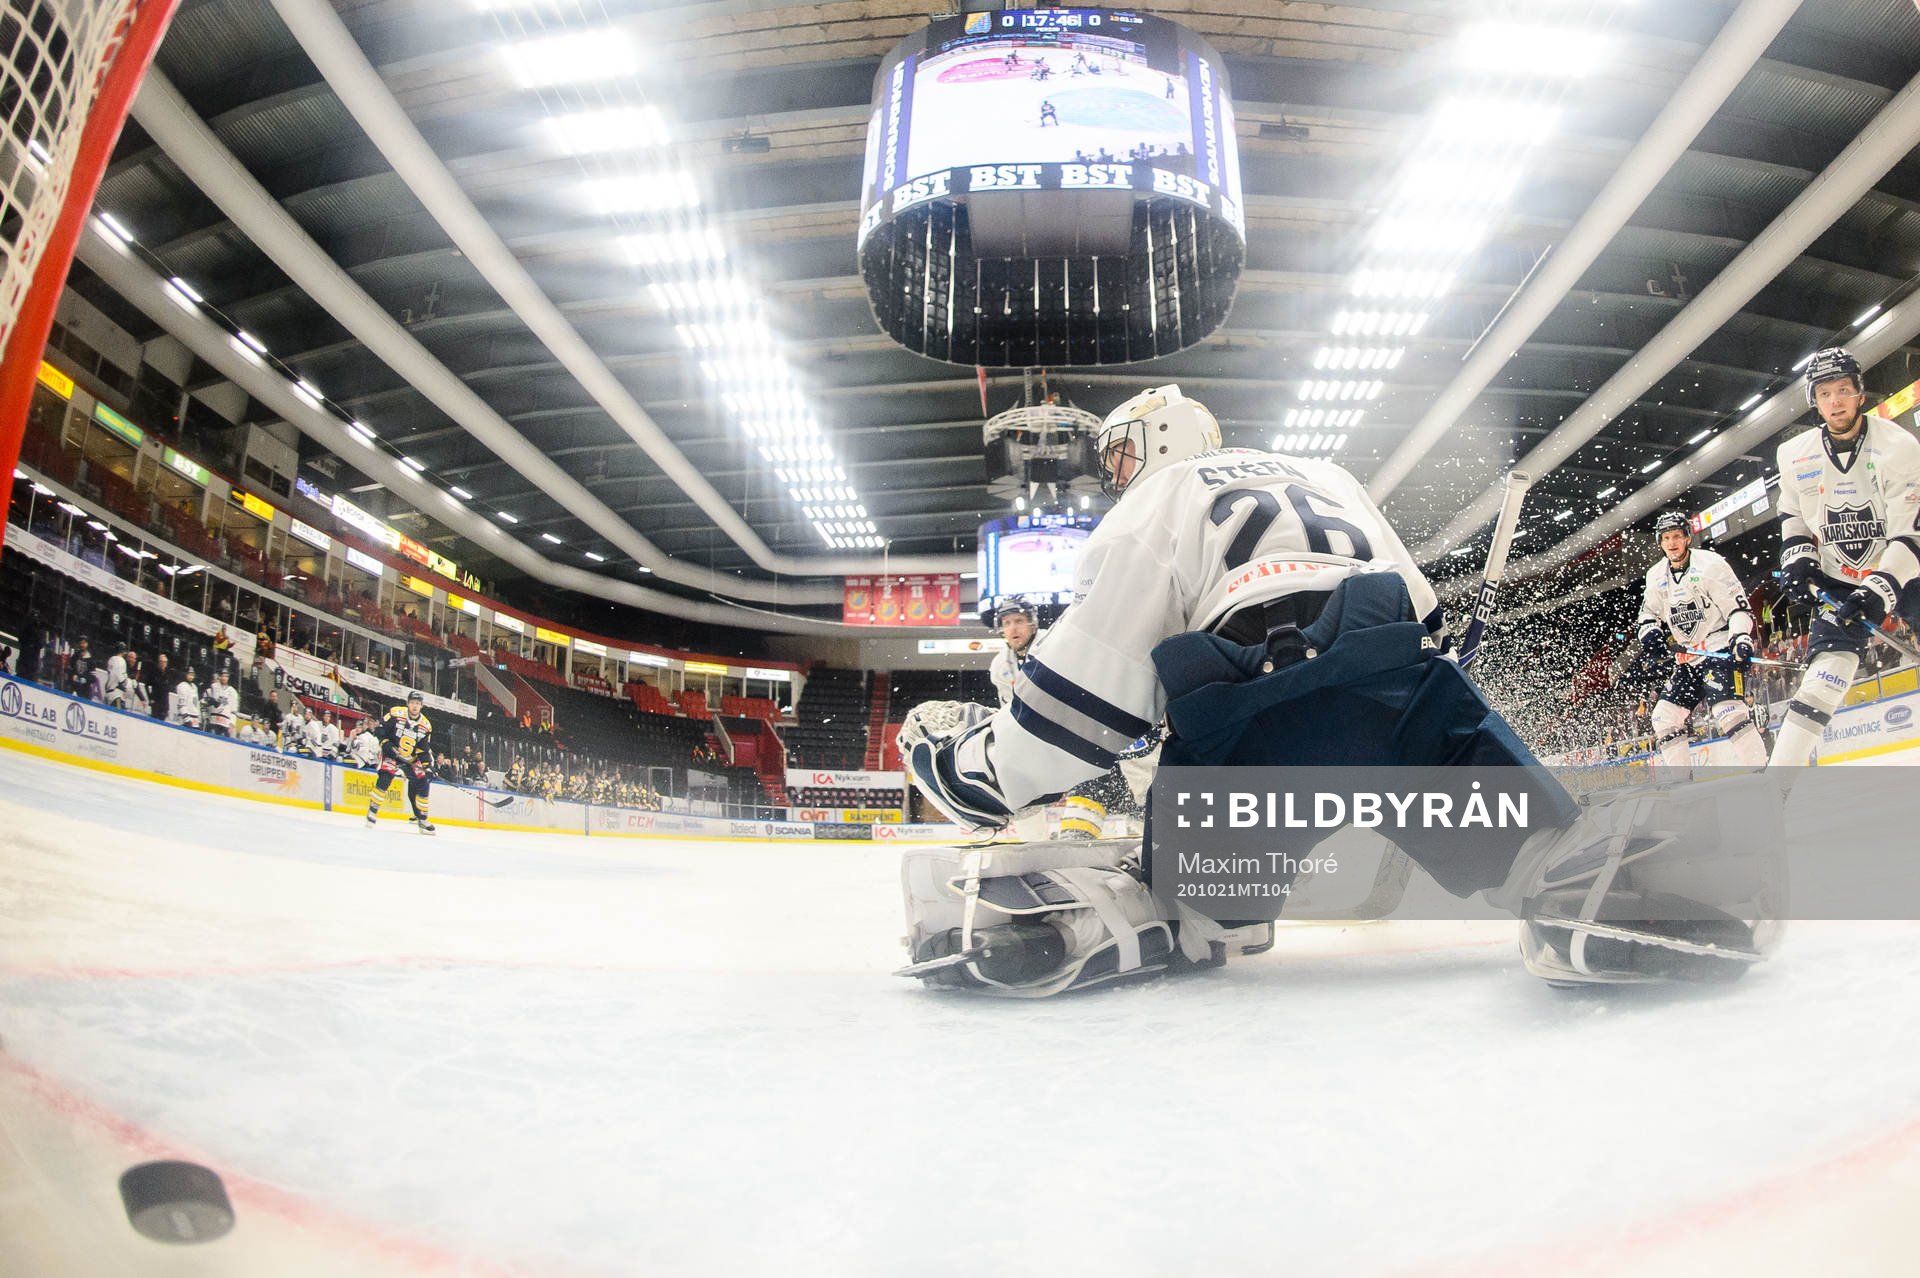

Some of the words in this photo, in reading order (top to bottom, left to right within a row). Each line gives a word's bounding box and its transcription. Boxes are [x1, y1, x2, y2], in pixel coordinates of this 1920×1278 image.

[1002, 16, 1014, 27] 0
[1089, 15, 1101, 26] 0
[970, 164, 1041, 186] BST
[1061, 164, 1132, 186] BST
[892, 170, 951, 208] BST
[1152, 168, 1210, 204] BST
[1210, 484, 1374, 571] 26
[1840, 513, 1857, 522] BIK
[1822, 521, 1885, 543] KARLSKOGA
[287, 674, 329, 700] SCNI
[25, 702, 38, 718] EL
[41, 708, 57, 722] AB
[88, 721, 100, 734] EL
[104, 726, 118, 738] AB
[813, 773, 833, 784] ICA
[800, 810, 829, 821] CWT
[775, 827, 812, 835] SCANIA
[875, 827, 896, 838] ICA
